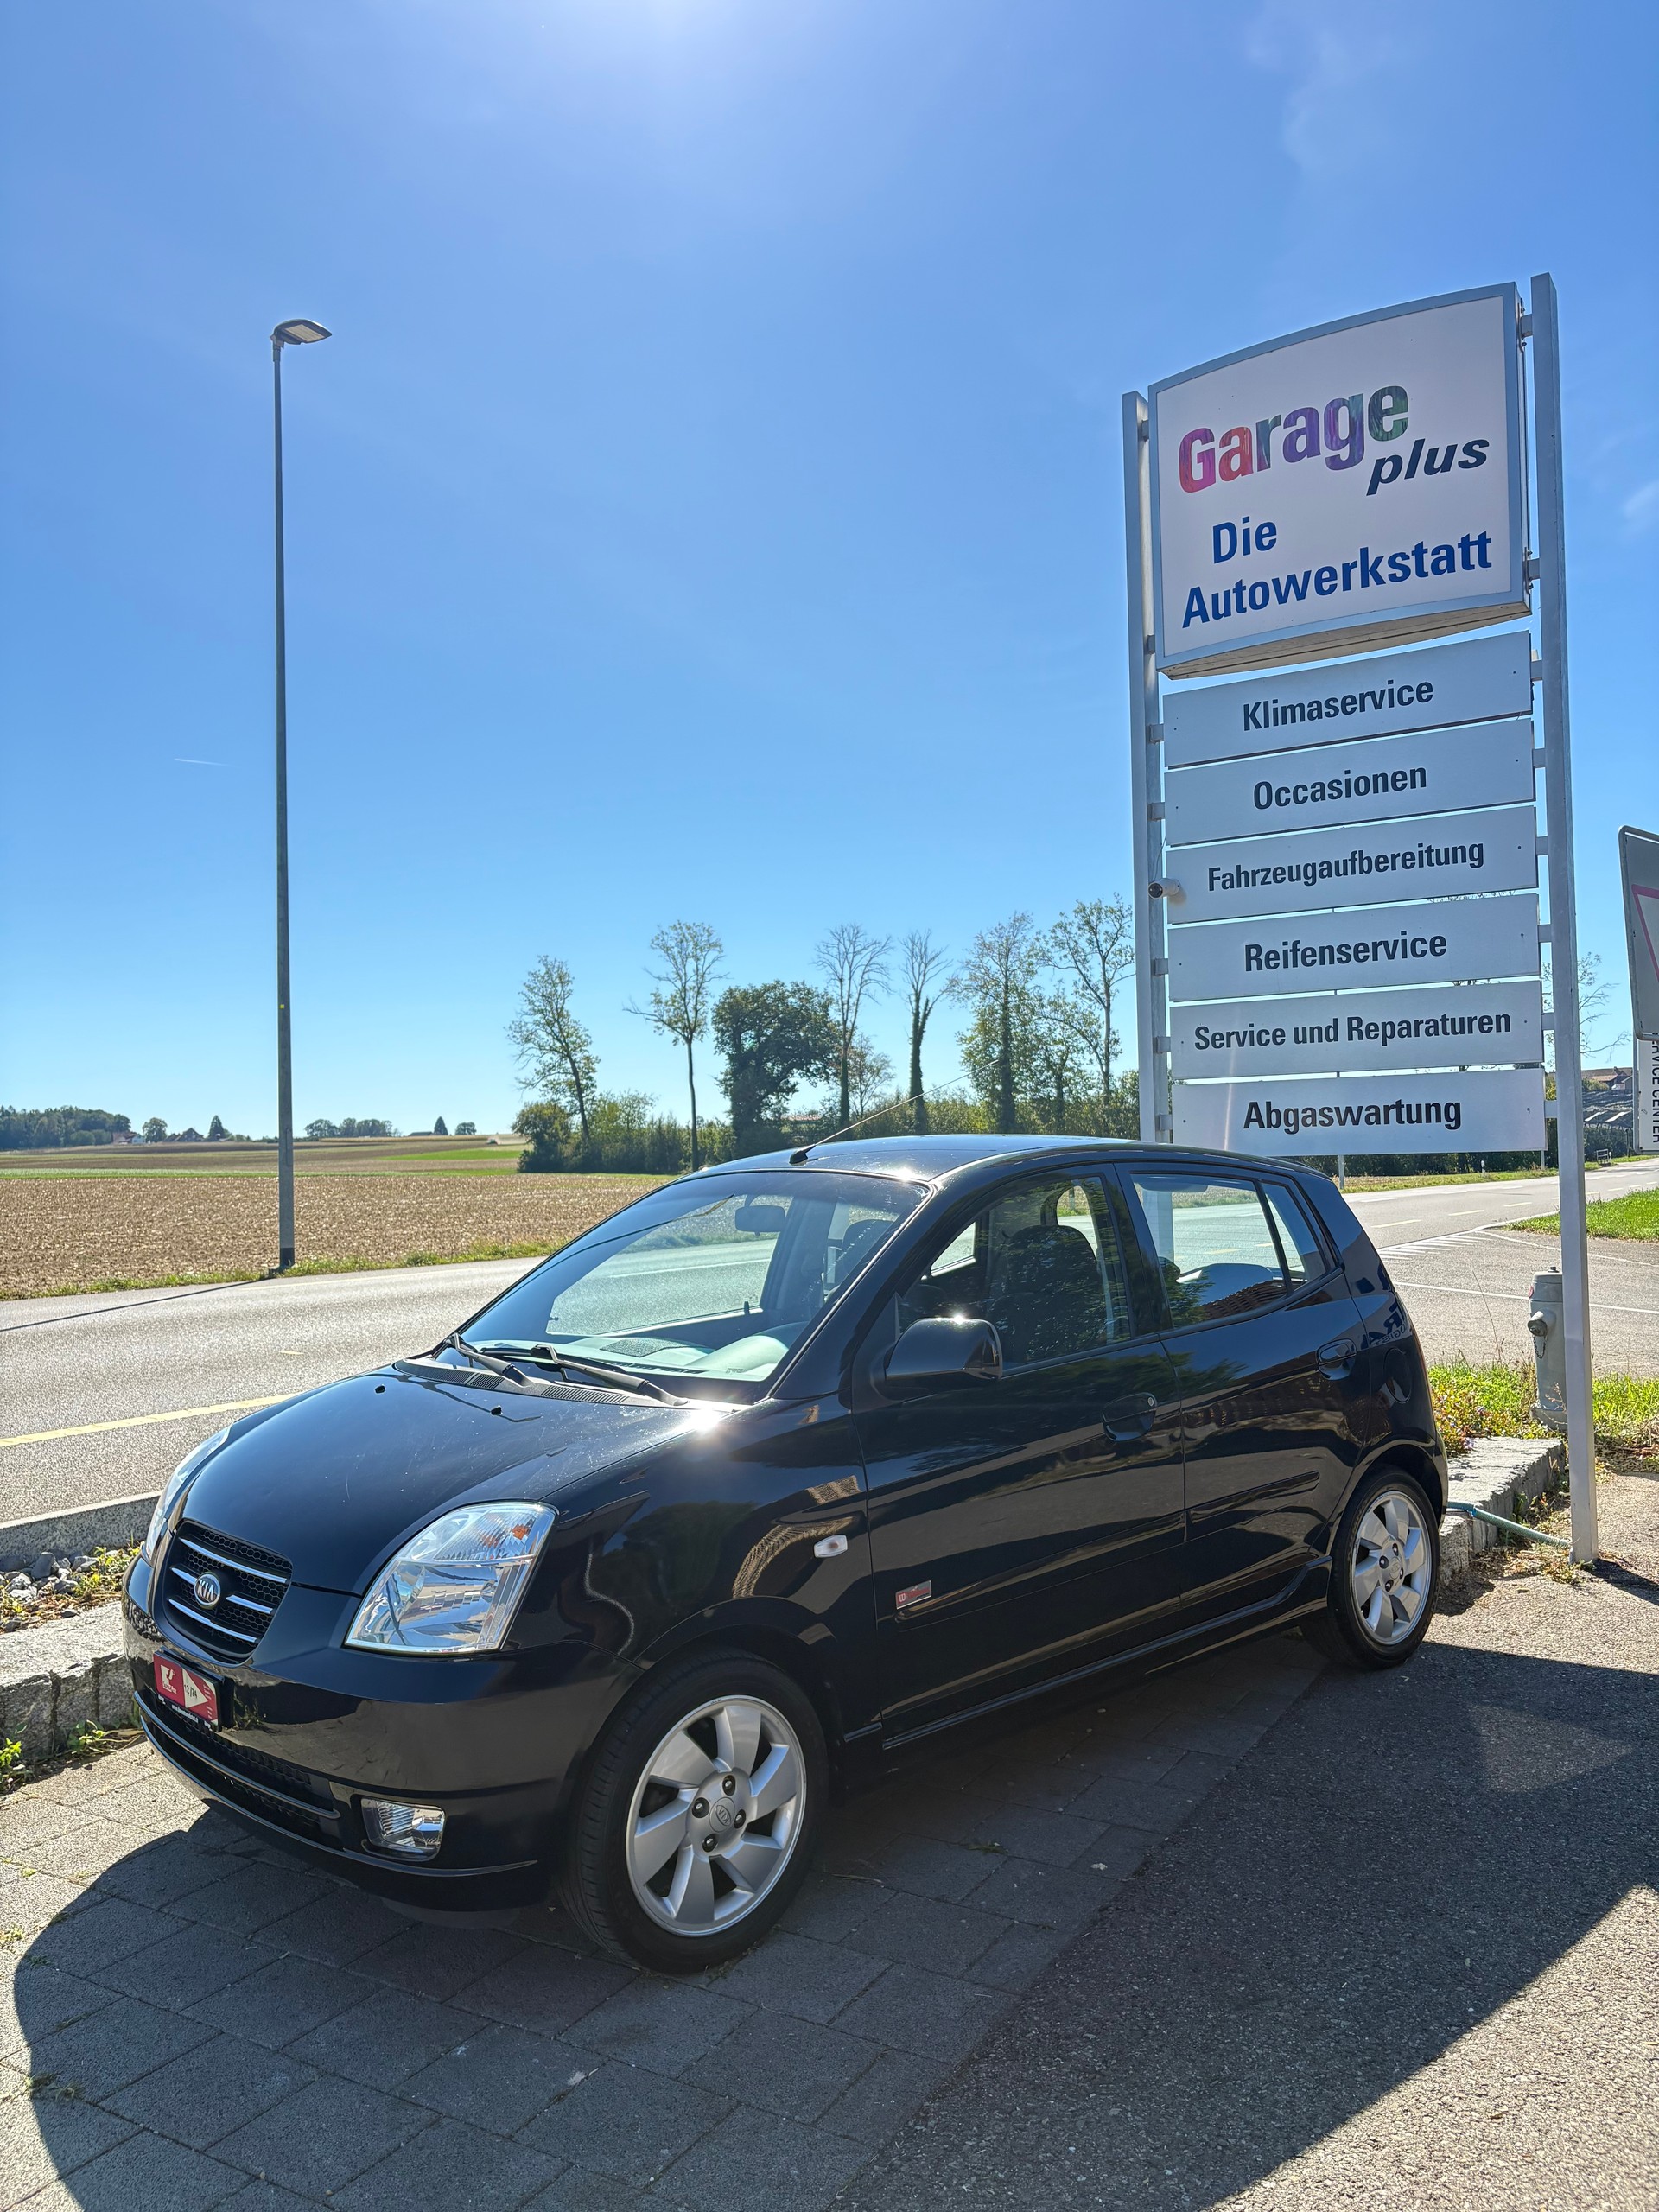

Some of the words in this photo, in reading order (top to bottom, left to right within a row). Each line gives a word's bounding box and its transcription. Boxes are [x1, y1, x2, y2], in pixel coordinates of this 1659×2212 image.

[1178, 385, 1409, 494] Garage
[1366, 438, 1490, 496] plus
[1212, 516, 1277, 564] Die
[1182, 531, 1492, 629] Autowerkstatt
[1243, 679, 1434, 732] Klimaservice
[1253, 766, 1427, 810] Occasionen
[1207, 841, 1484, 892] Fahrzeugaufbereitung
[1244, 930, 1447, 972] Reifenservice
[1194, 1022, 1287, 1051] Service
[1294, 1017, 1339, 1045] und
[1347, 1011, 1511, 1047] Reparaturen
[1243, 1099, 1462, 1135] Abgaswartung
[198, 1579, 214, 1601] KIA
